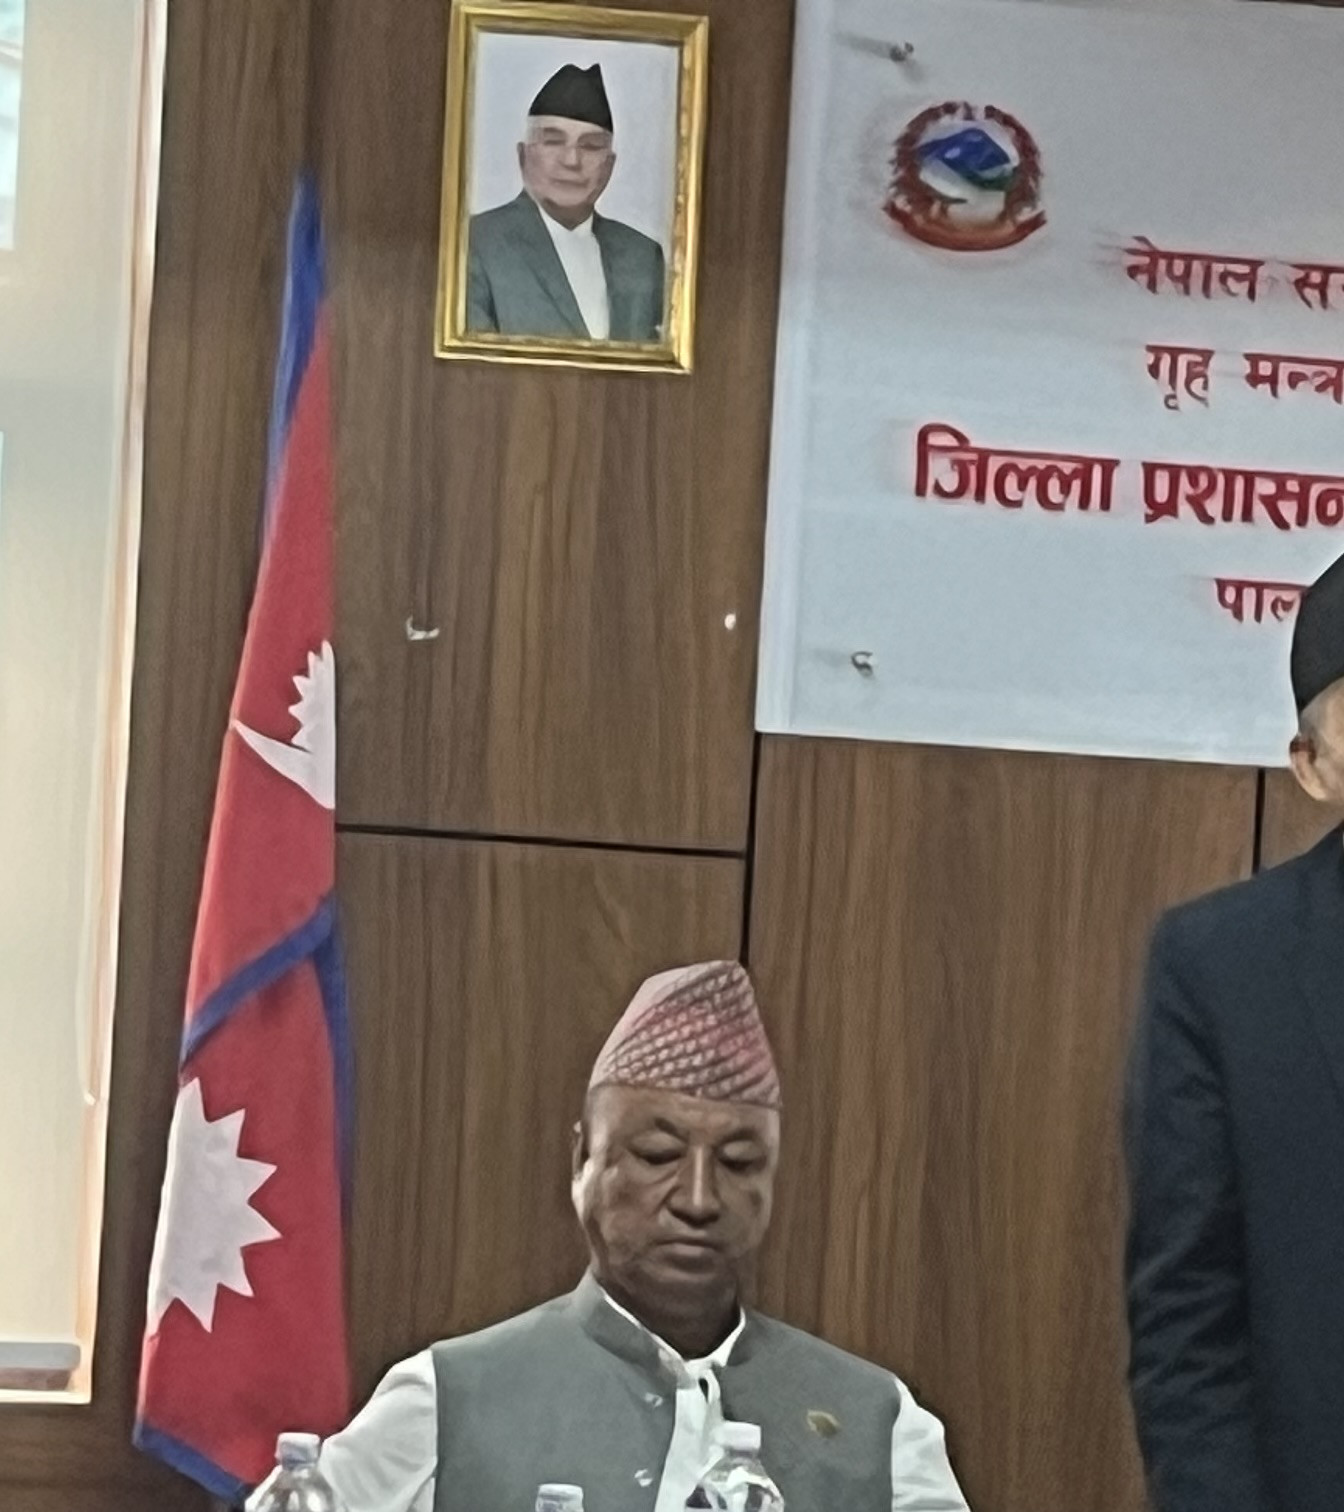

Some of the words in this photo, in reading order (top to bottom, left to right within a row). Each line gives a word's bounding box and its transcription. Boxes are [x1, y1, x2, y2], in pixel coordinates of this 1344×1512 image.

[1123, 235, 1266, 303] नेपाल
[1145, 344, 1215, 412] गृह
[914, 422, 1121, 513] जिल्ला
[1214, 577, 1312, 624] पाल
